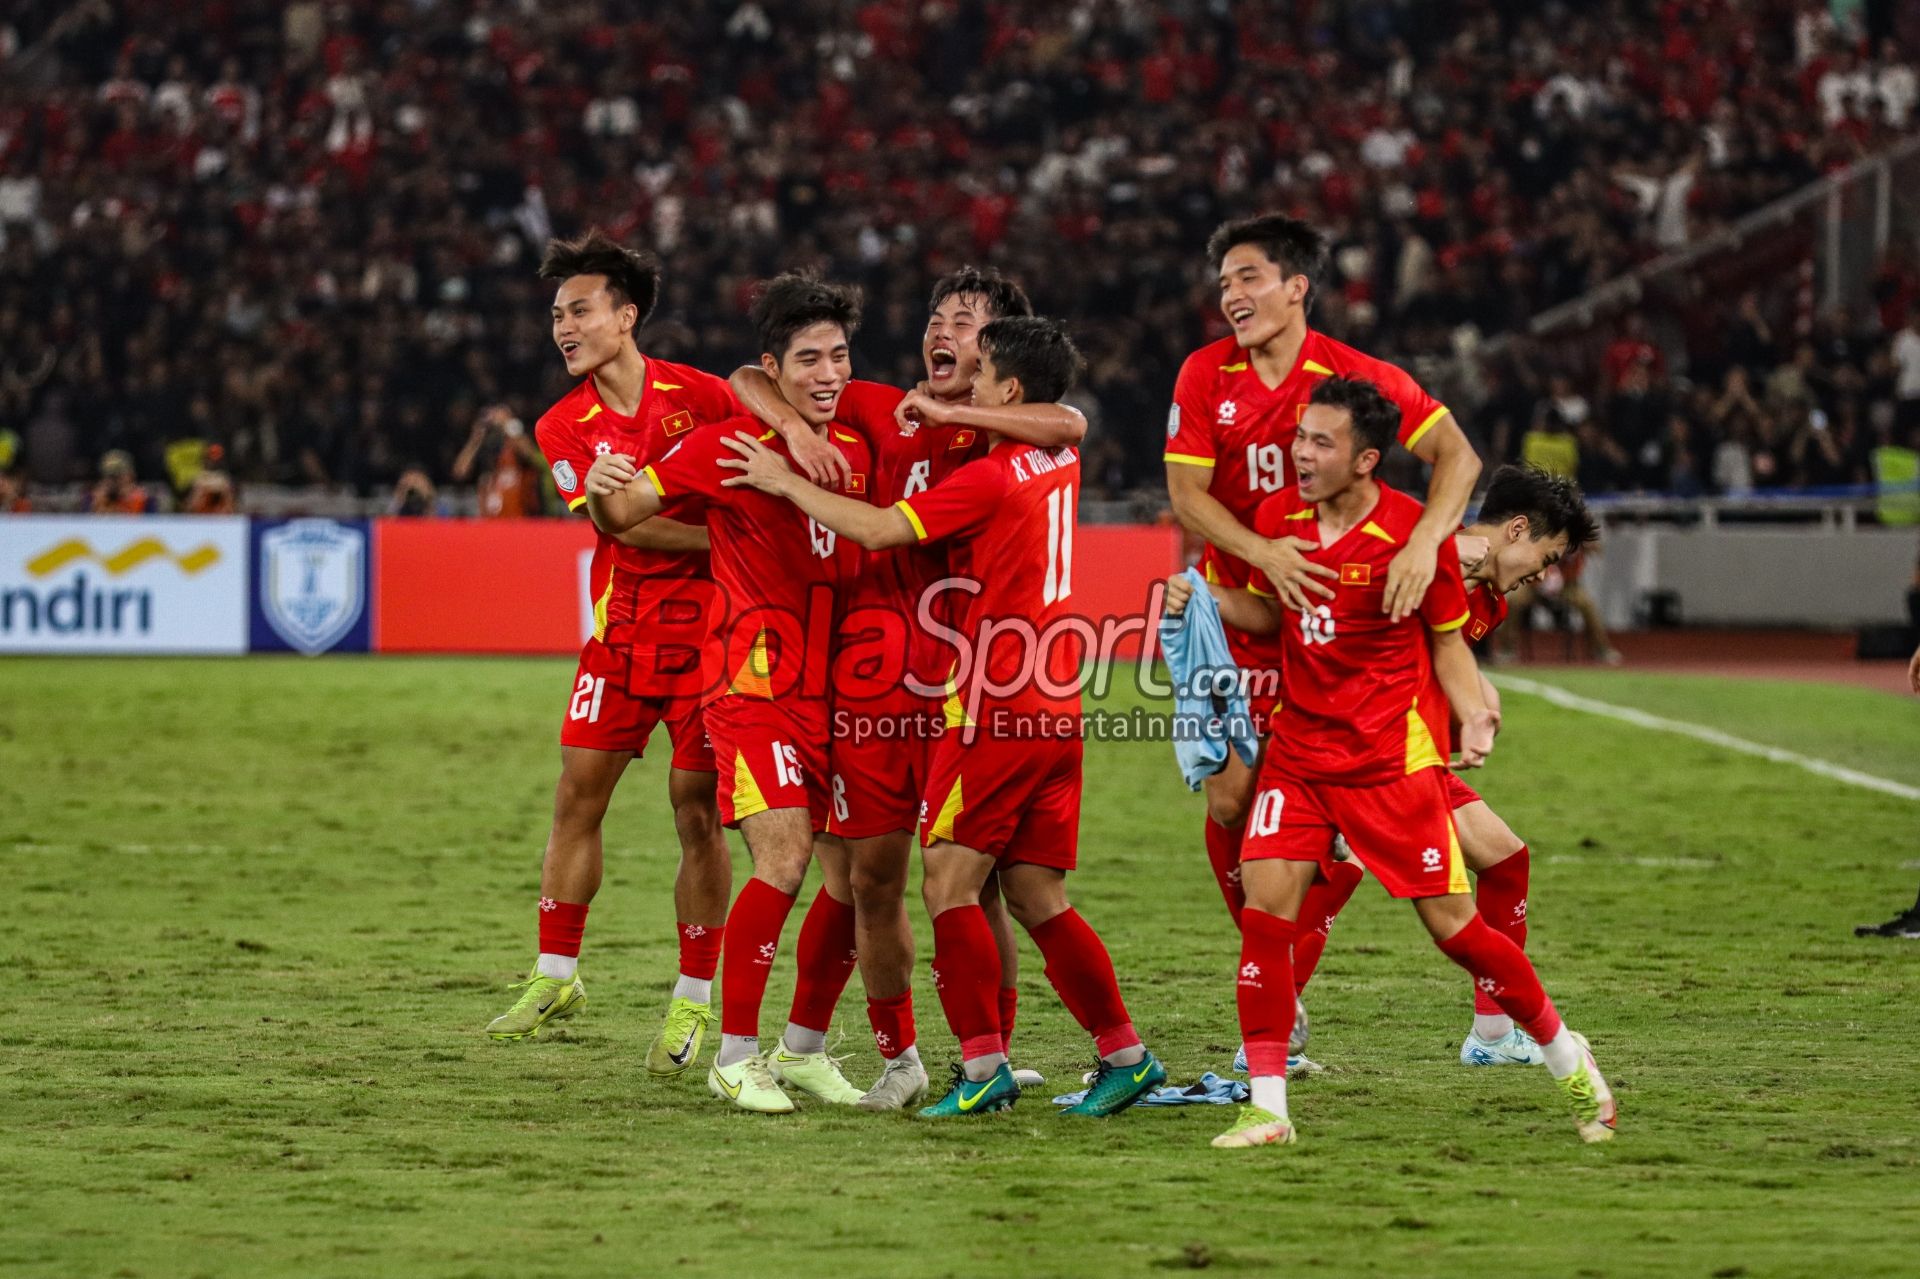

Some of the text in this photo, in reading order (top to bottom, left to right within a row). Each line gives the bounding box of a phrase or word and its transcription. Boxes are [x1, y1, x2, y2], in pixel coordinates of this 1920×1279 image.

[904, 459, 930, 499] 8
[1247, 443, 1285, 493] 19
[1043, 482, 1073, 607] 11
[2, 571, 150, 632] ndiri
[1300, 604, 1336, 646] 10
[569, 672, 606, 723] 21
[1249, 788, 1285, 838] 10
